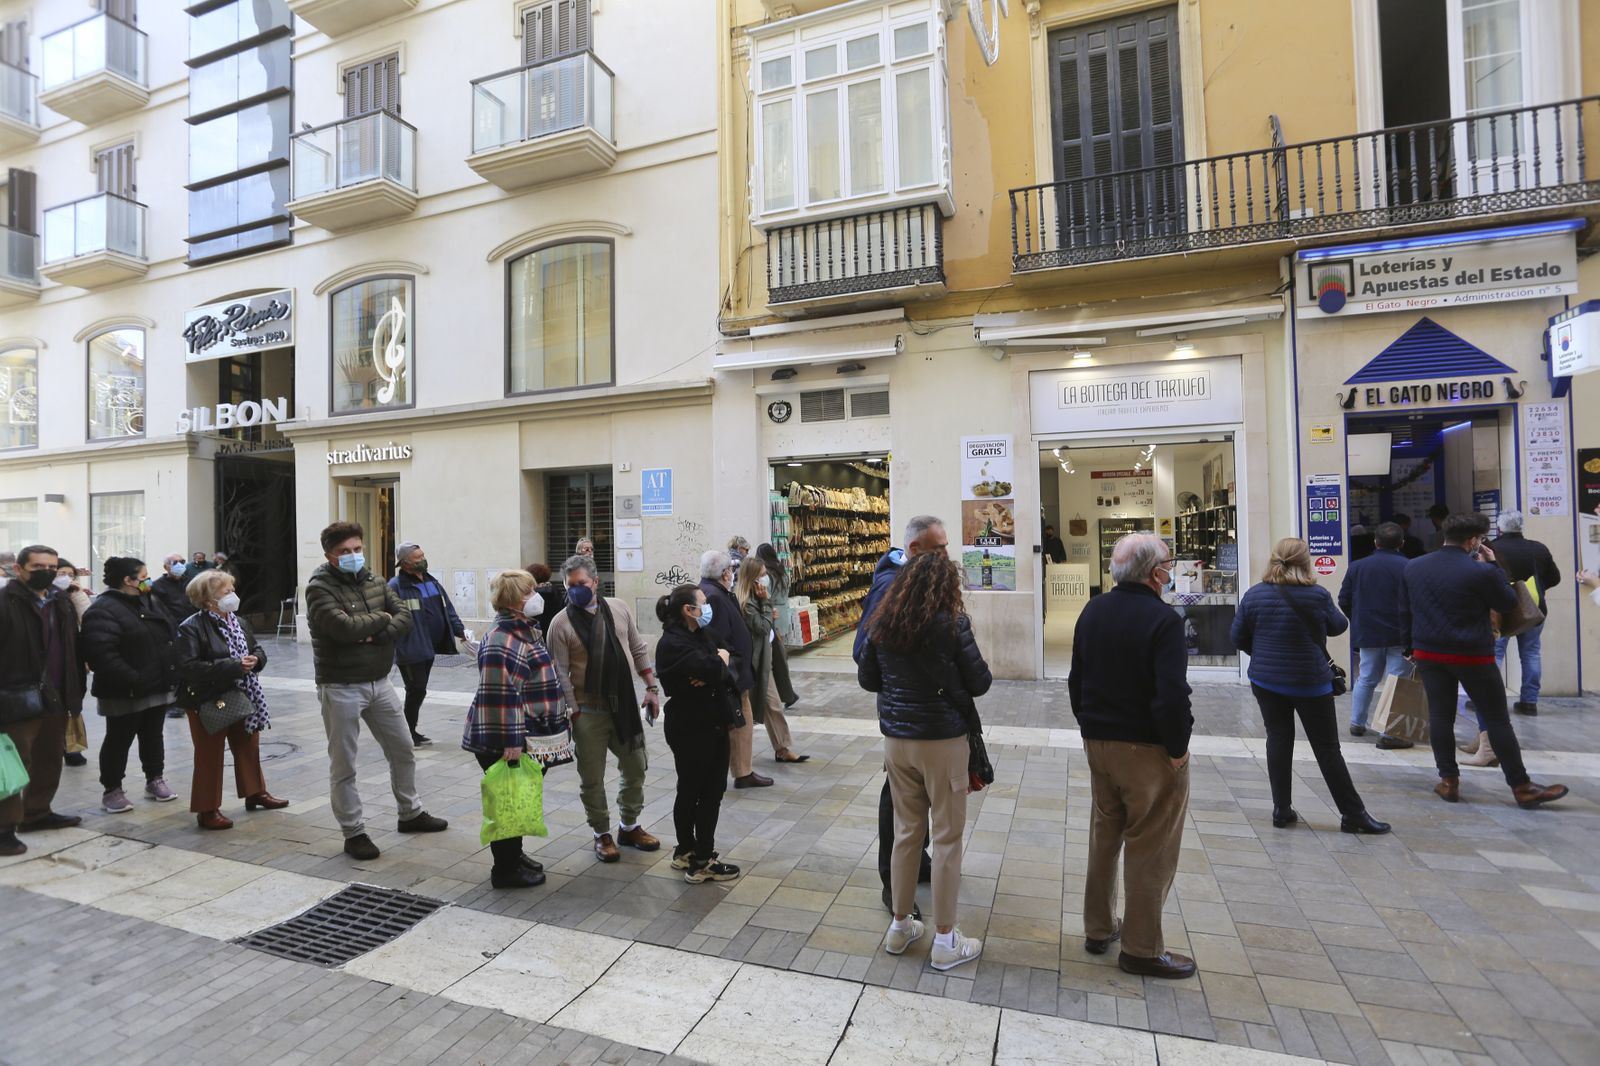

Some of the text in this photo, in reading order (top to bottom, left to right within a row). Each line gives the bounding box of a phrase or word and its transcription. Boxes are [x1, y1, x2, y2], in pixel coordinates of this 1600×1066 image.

[1360, 257, 1453, 276] Loterías y
[1362, 262, 1561, 297] Apuestas del Estado
[1377, 301, 1401, 309] Gato
[1407, 299, 1437, 307] Negro
[1064, 376, 1205, 404] LA BOTTEGA DEL TARTUFO
[1366, 380, 1494, 405] EL GATO NEGRO
[176, 396, 288, 436] SILBON
[326, 441, 412, 464] stradivarius
[972, 448, 1002, 456] GRATIS
[647, 472, 667, 489] AT
[1051, 582, 1085, 596] TARTUFO
